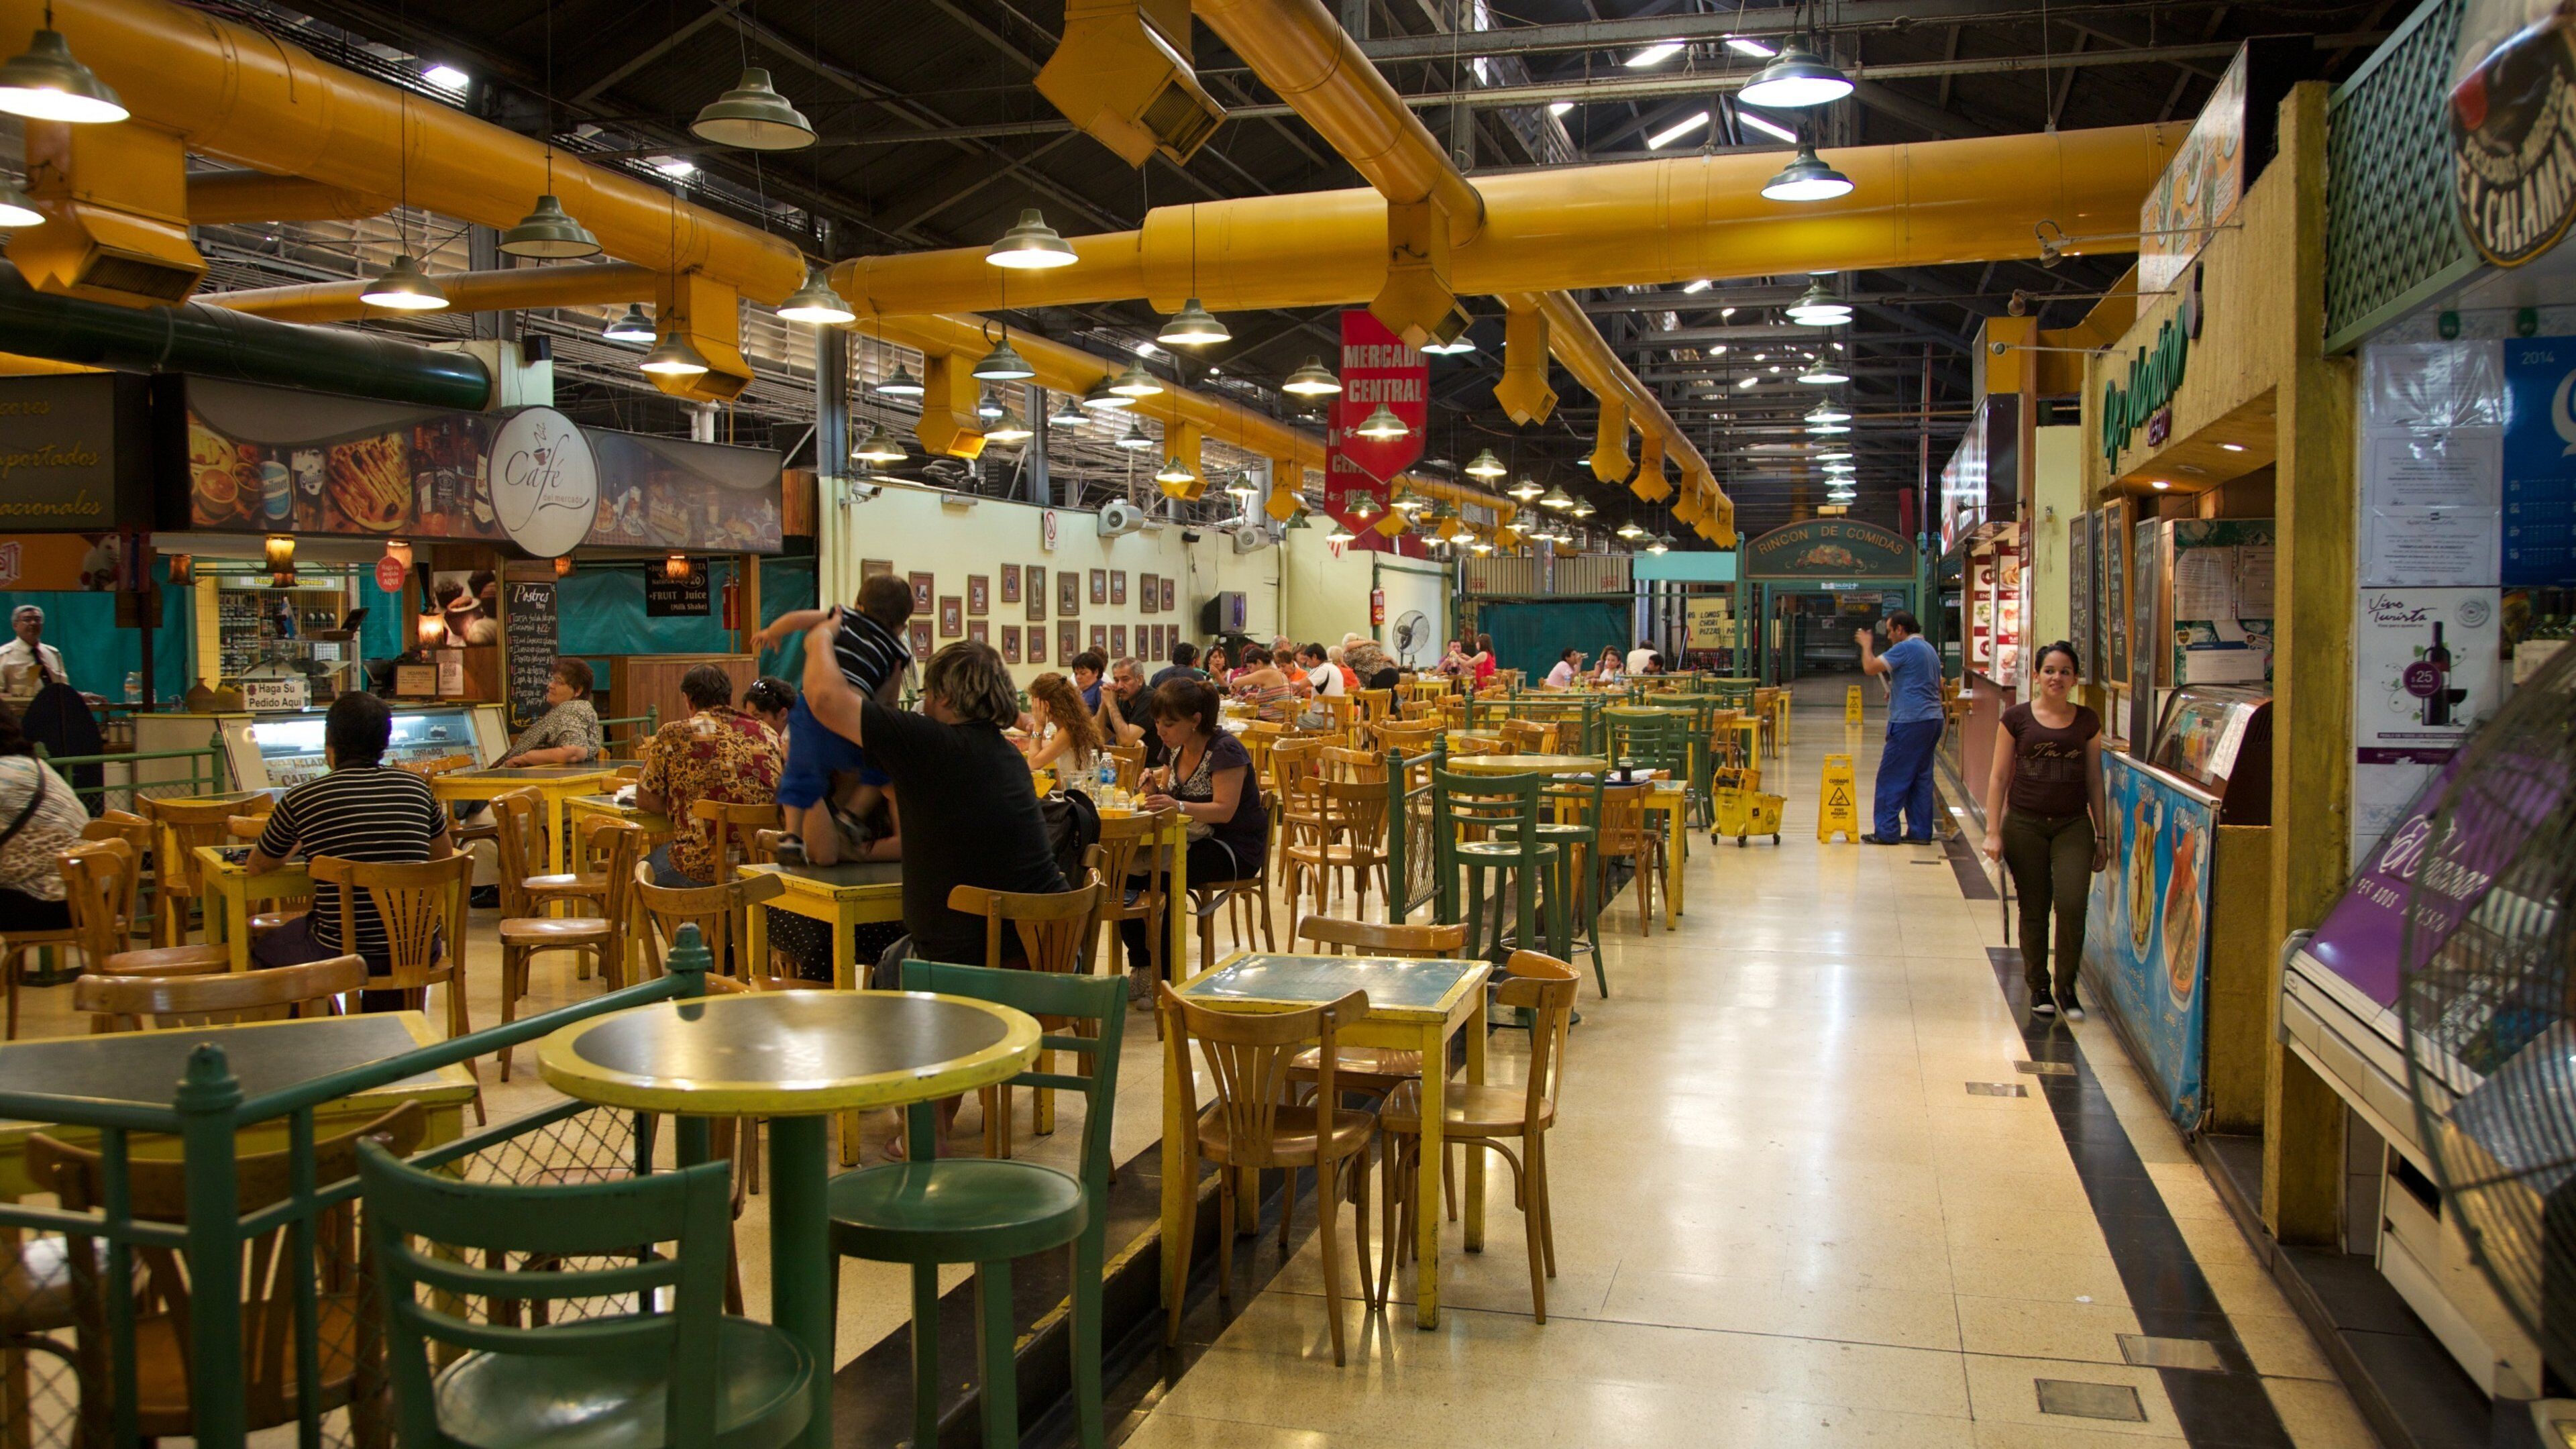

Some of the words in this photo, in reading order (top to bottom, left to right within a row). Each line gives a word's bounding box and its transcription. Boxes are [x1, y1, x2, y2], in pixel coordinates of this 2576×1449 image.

[1344, 343, 1426, 368] MERCADO
[2522, 352, 2555, 365] 2014
[1348, 379, 1423, 402] CENTRAL
[505, 434, 569, 532] Café
[555, 495, 583, 503] mercado
[1758, 529, 1809, 555] RINCON
[1821, 526, 1839, 537] DE
[1846, 527, 1904, 555] COMIDAS
[515, 585, 549, 603] Postres
[652, 591, 677, 600] FRUIT
[685, 590, 707, 599] Juice
[2369, 594, 2404, 609] Vino
[2369, 607, 2436, 623] Turista
[259, 684, 282, 695] Haga
[284, 684, 295, 693] Su
[249, 698, 280, 707] Pedido
